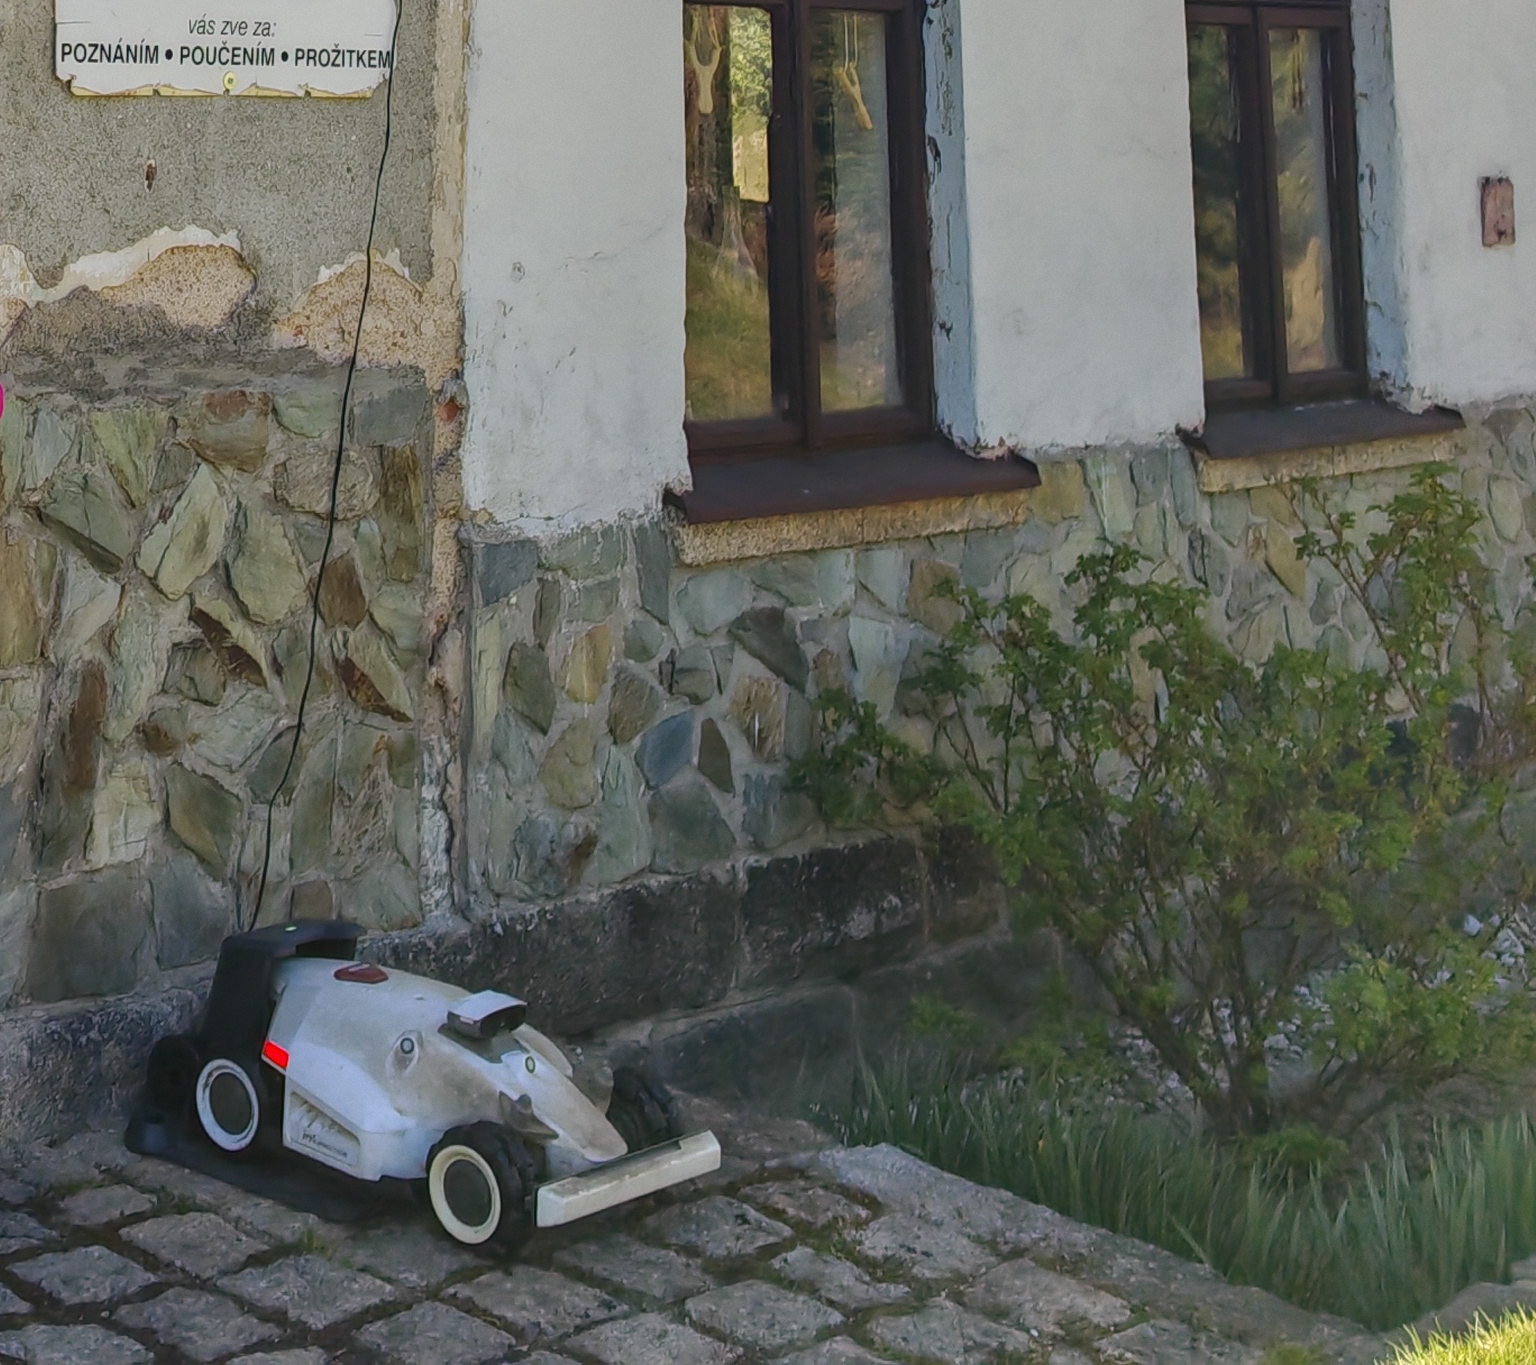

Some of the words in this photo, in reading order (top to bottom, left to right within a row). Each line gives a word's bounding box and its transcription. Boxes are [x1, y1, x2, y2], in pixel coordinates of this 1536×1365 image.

[188, 13, 216, 36] vás
[220, 20, 249, 37] zve
[252, 20, 278, 38] za:
[60, 37, 160, 65] POZNÁNÍM
[179, 40, 276, 67] POUČENÍM
[294, 43, 392, 69] PROŽITKEM
